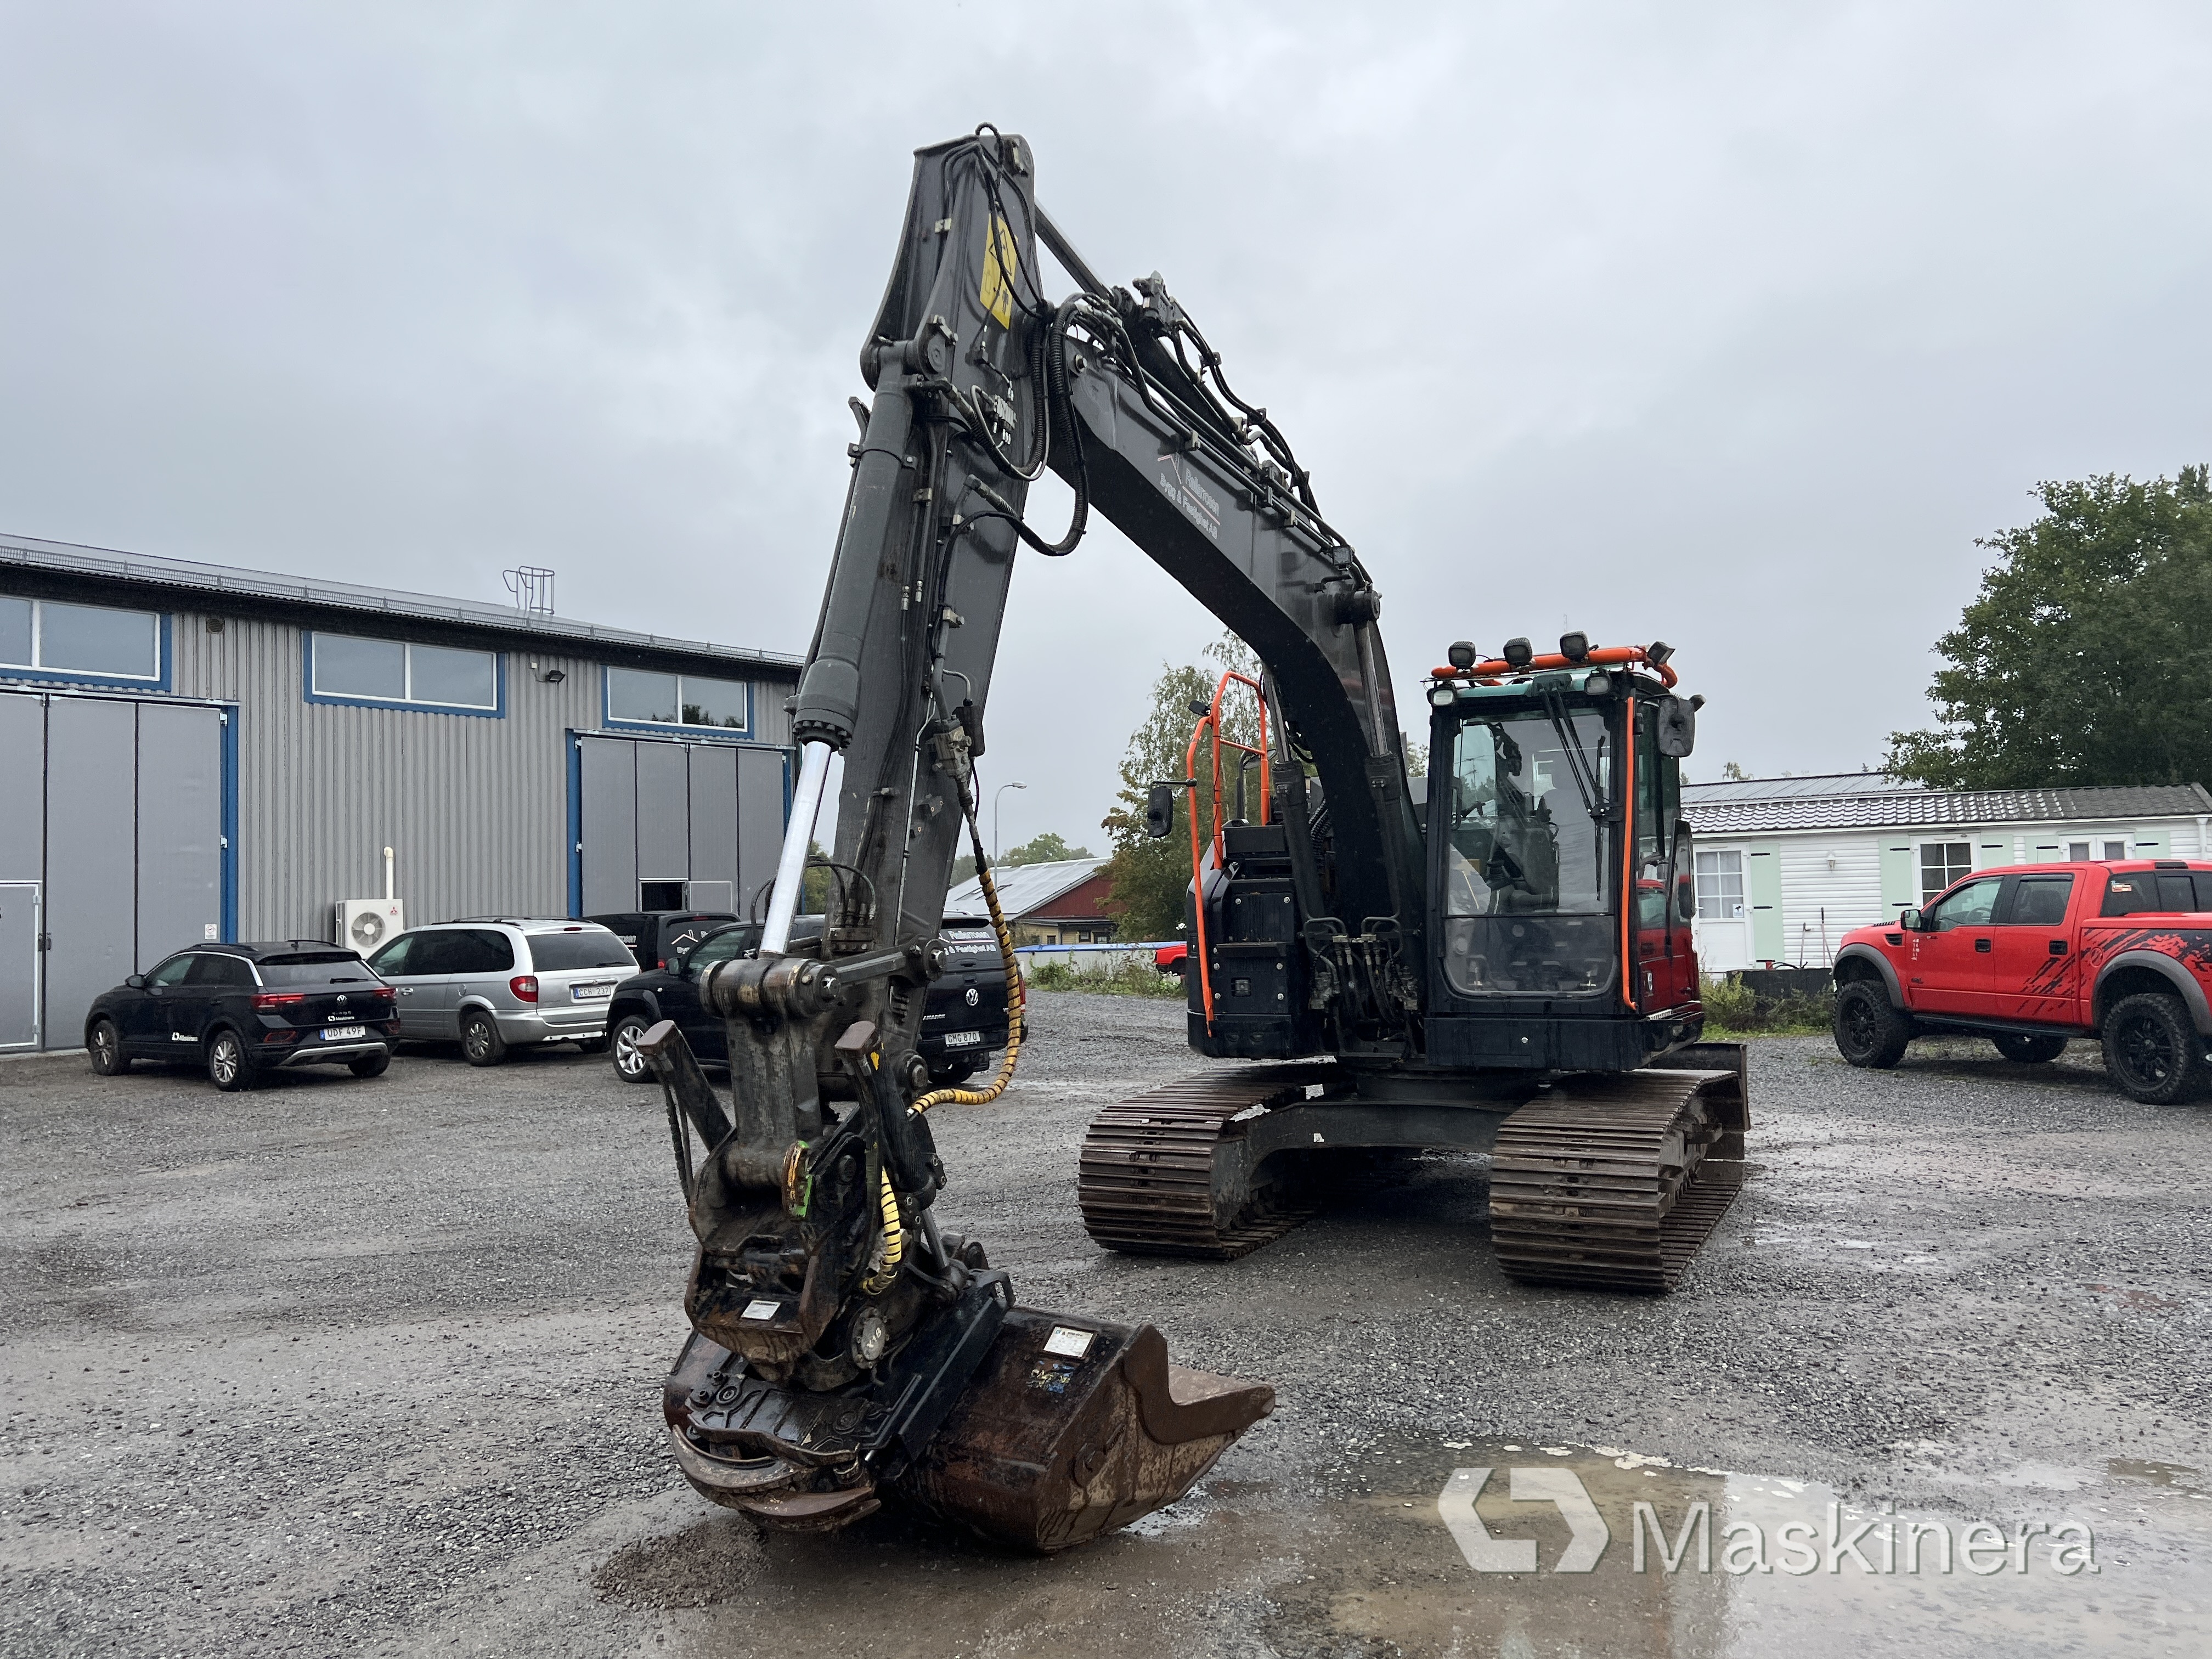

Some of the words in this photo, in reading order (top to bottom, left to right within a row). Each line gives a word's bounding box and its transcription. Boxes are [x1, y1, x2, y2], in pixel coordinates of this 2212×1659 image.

[579, 988, 592, 996] CCH
[596, 986, 609, 995] 237
[327, 1028, 343, 1037] UDF
[947, 1034, 962, 1043] GMG
[963, 1032, 977, 1042] 870
